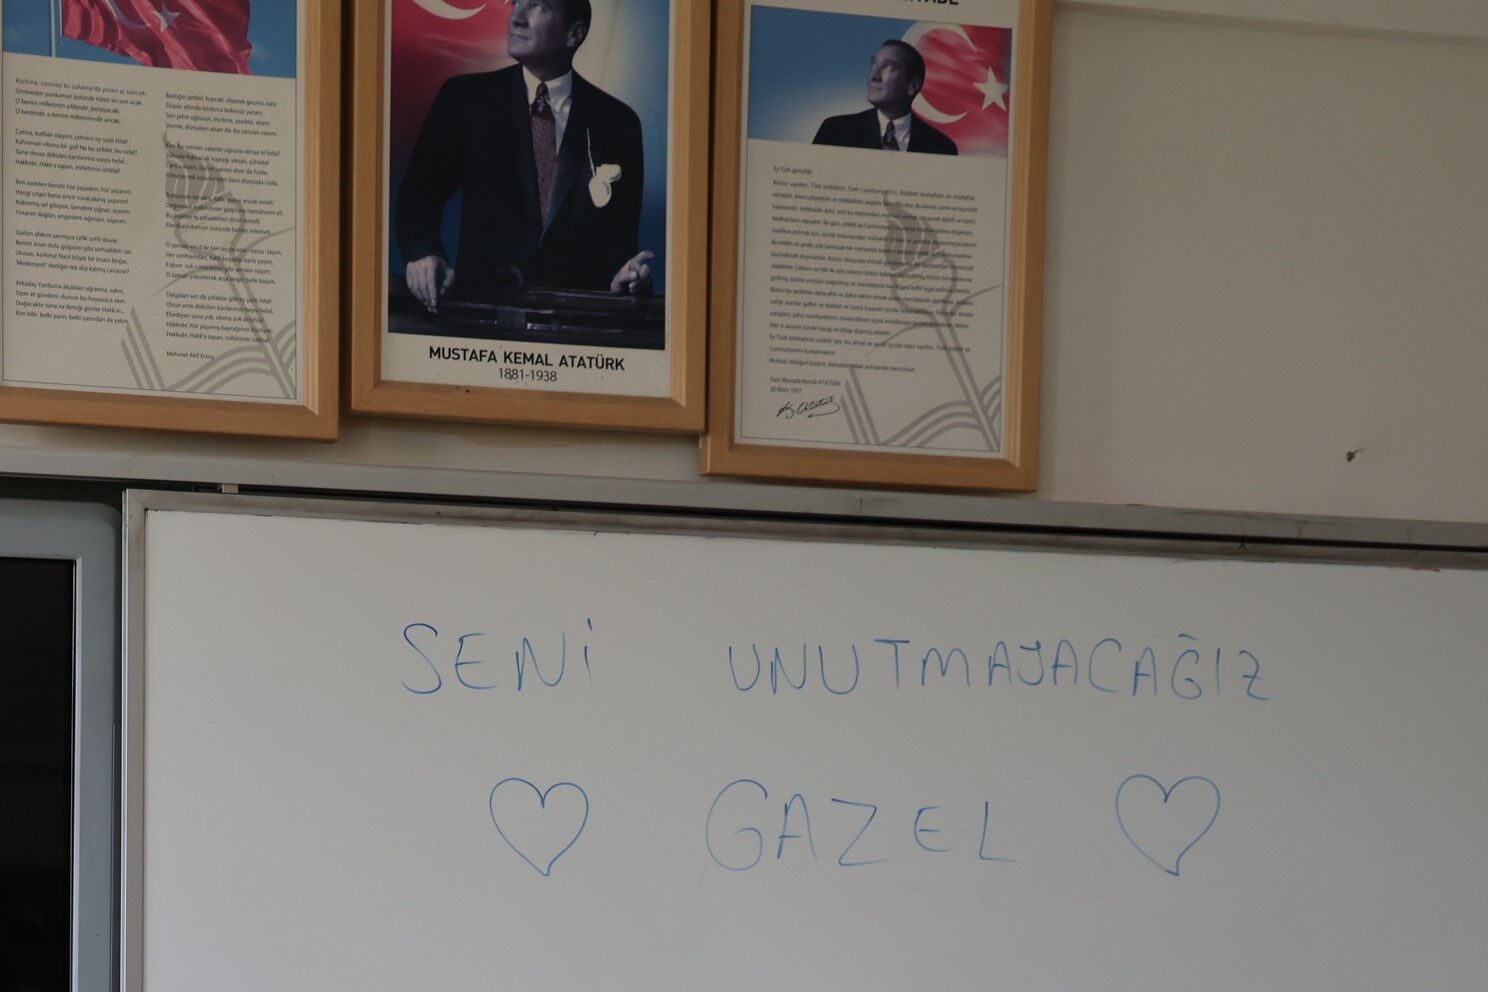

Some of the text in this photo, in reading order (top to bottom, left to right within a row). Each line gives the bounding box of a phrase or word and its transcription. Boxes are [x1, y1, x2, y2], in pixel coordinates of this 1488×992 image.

[428, 345, 626, 371] MUSTAFA KEMAL ATATÜRK
[498, 367, 558, 383] 1881-1938
[705, 777, 1020, 871] GAZEL
